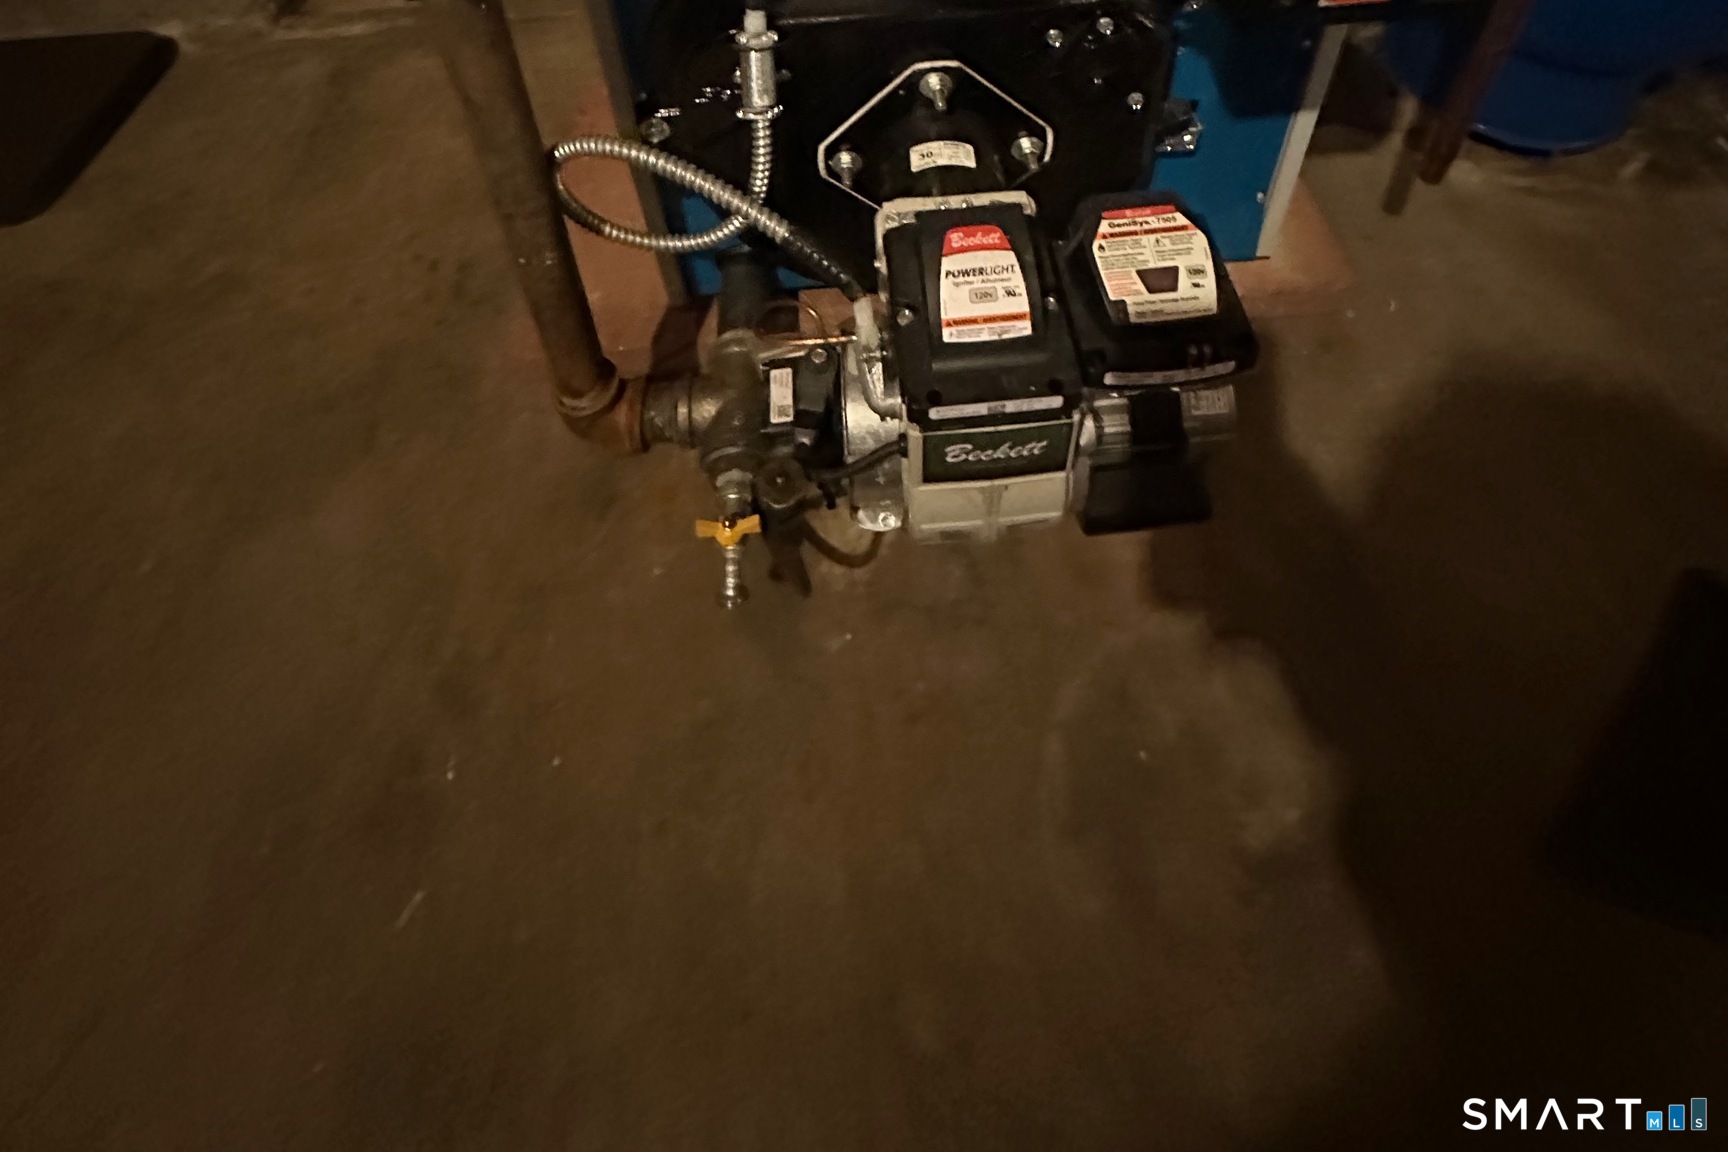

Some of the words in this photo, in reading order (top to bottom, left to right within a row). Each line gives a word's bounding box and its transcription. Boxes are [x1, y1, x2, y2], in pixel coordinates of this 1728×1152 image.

[950, 232, 1001, 248] Beckett
[945, 264, 1016, 280] POWERLIGHT
[944, 440, 1049, 463] Beckett
